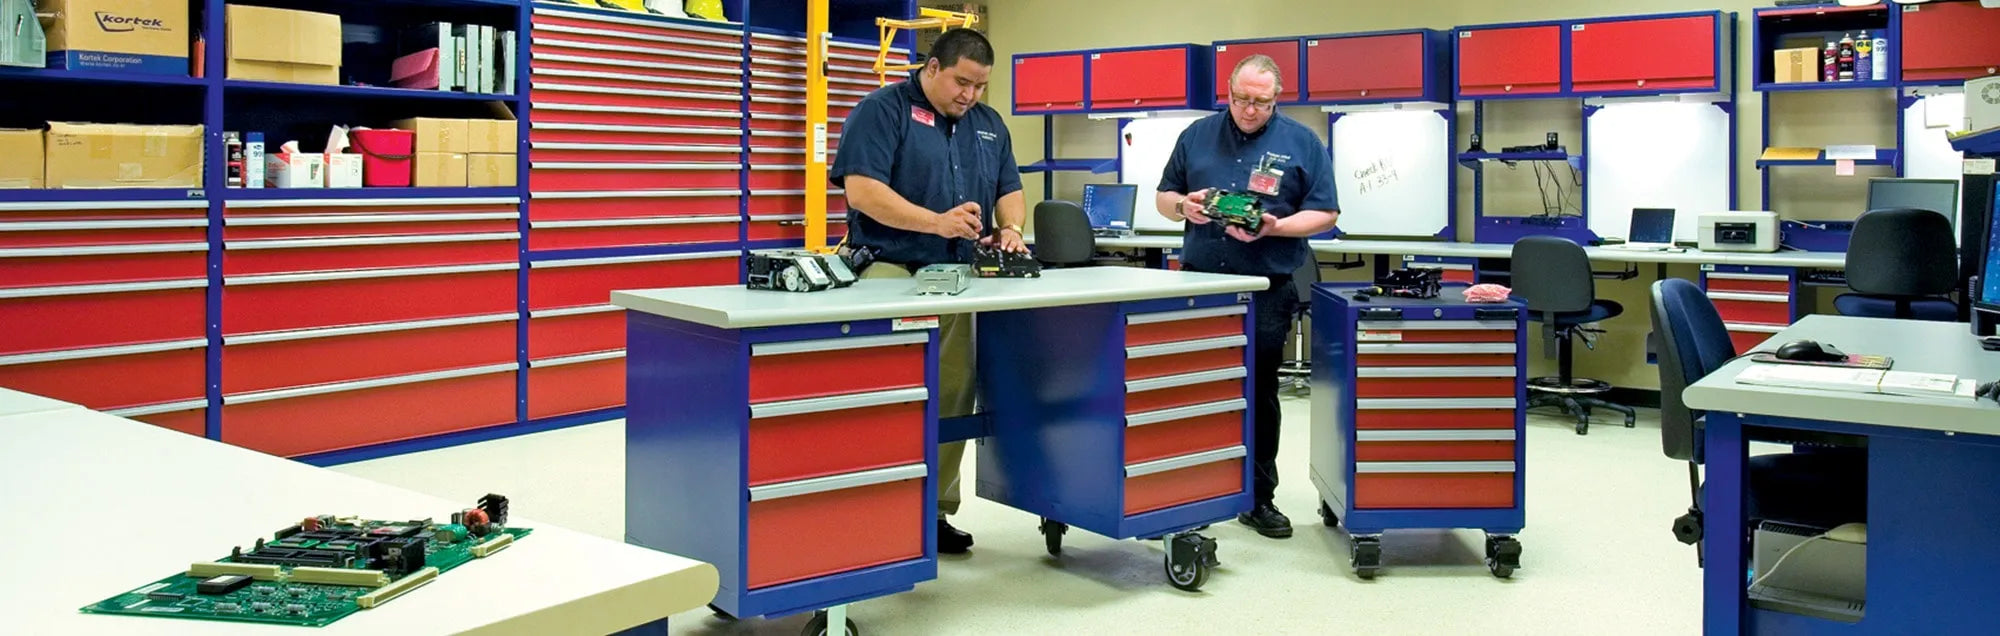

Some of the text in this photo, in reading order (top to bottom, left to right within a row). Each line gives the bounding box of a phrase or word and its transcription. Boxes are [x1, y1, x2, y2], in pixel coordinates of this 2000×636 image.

[103, 14, 162, 26] kortek
[79, 53, 143, 64] Kortek Corporation
